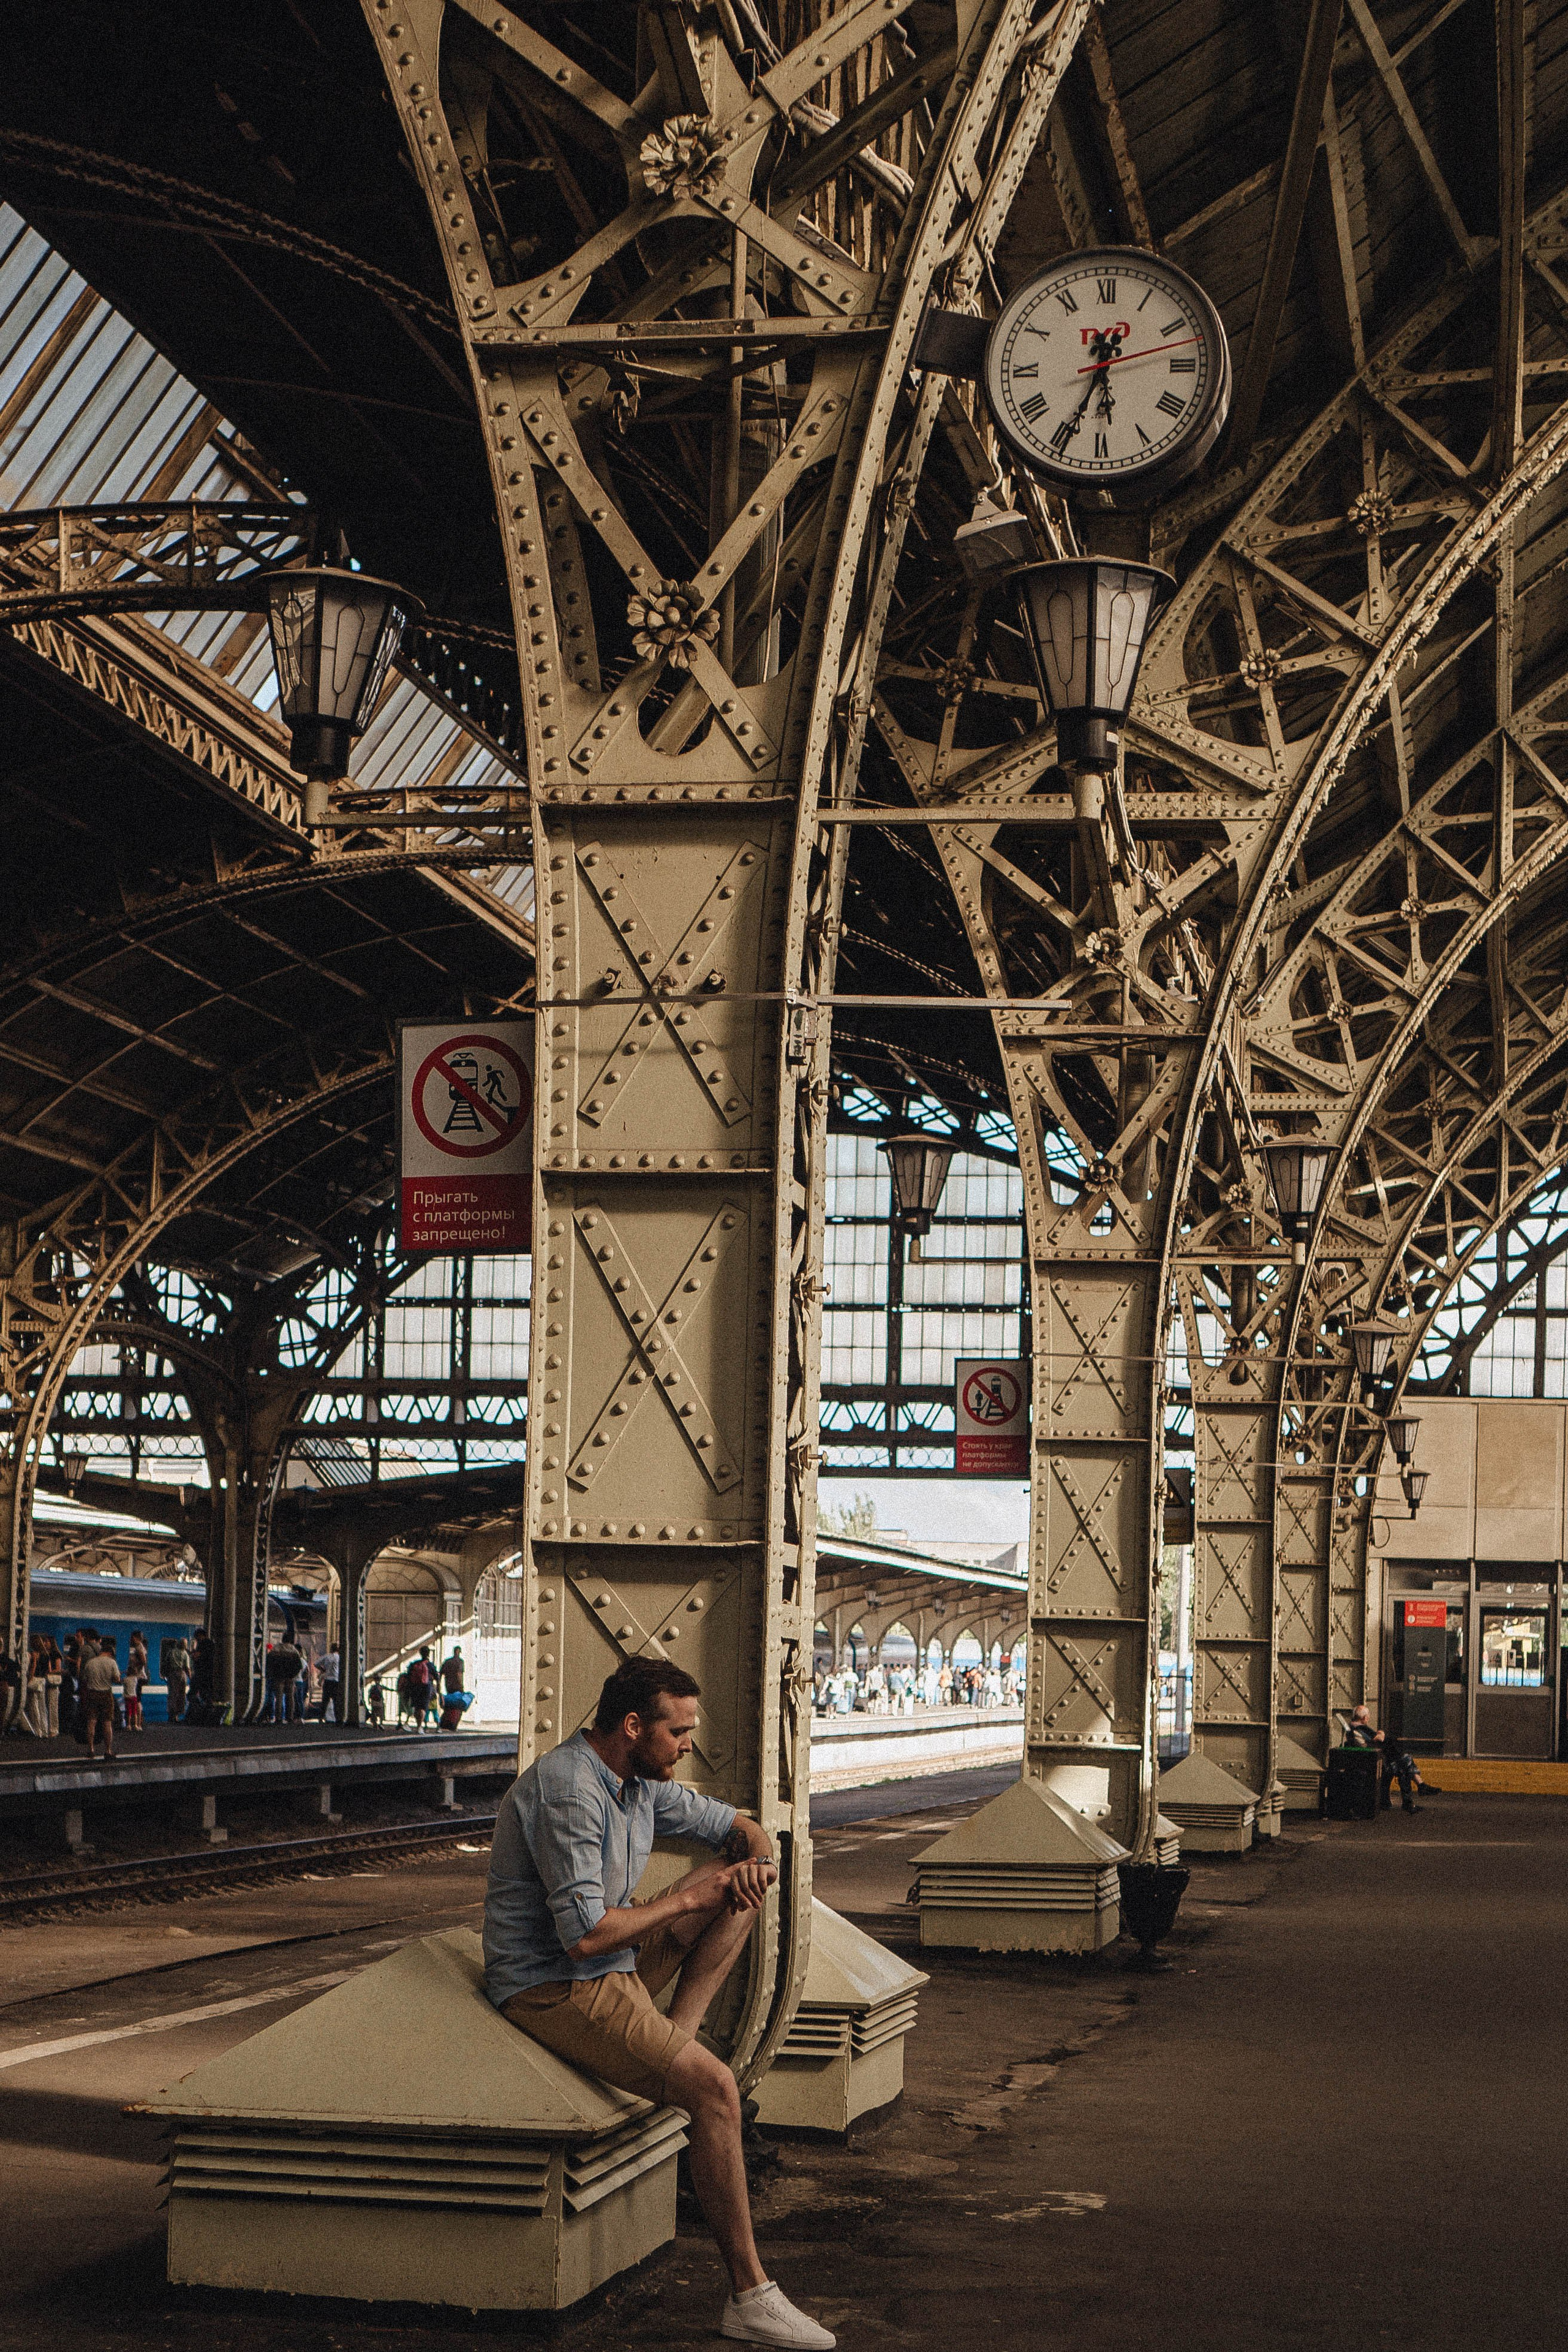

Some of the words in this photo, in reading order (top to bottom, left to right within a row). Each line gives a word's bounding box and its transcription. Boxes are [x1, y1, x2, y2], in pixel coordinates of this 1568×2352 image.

[1054, 288, 1079, 317] XI
[1096, 278, 1116, 305] XII
[1137, 288, 1153, 312] I
[1024, 322, 1050, 342] X
[1159, 317, 1186, 338] II
[1013, 362, 1039, 379] IX
[1169, 357, 1196, 374] III
[1019, 391, 1050, 425] VIII
[1155, 390, 1187, 420] IIII
[1095, 432, 1109, 458] VI
[1134, 423, 1153, 448] V
[413, 1191, 478, 1207] Прыгать
[413, 1212, 420, 1223] с
[424, 1208, 514, 1224] платформы
[413, 1226, 505, 1244] запрещено!
